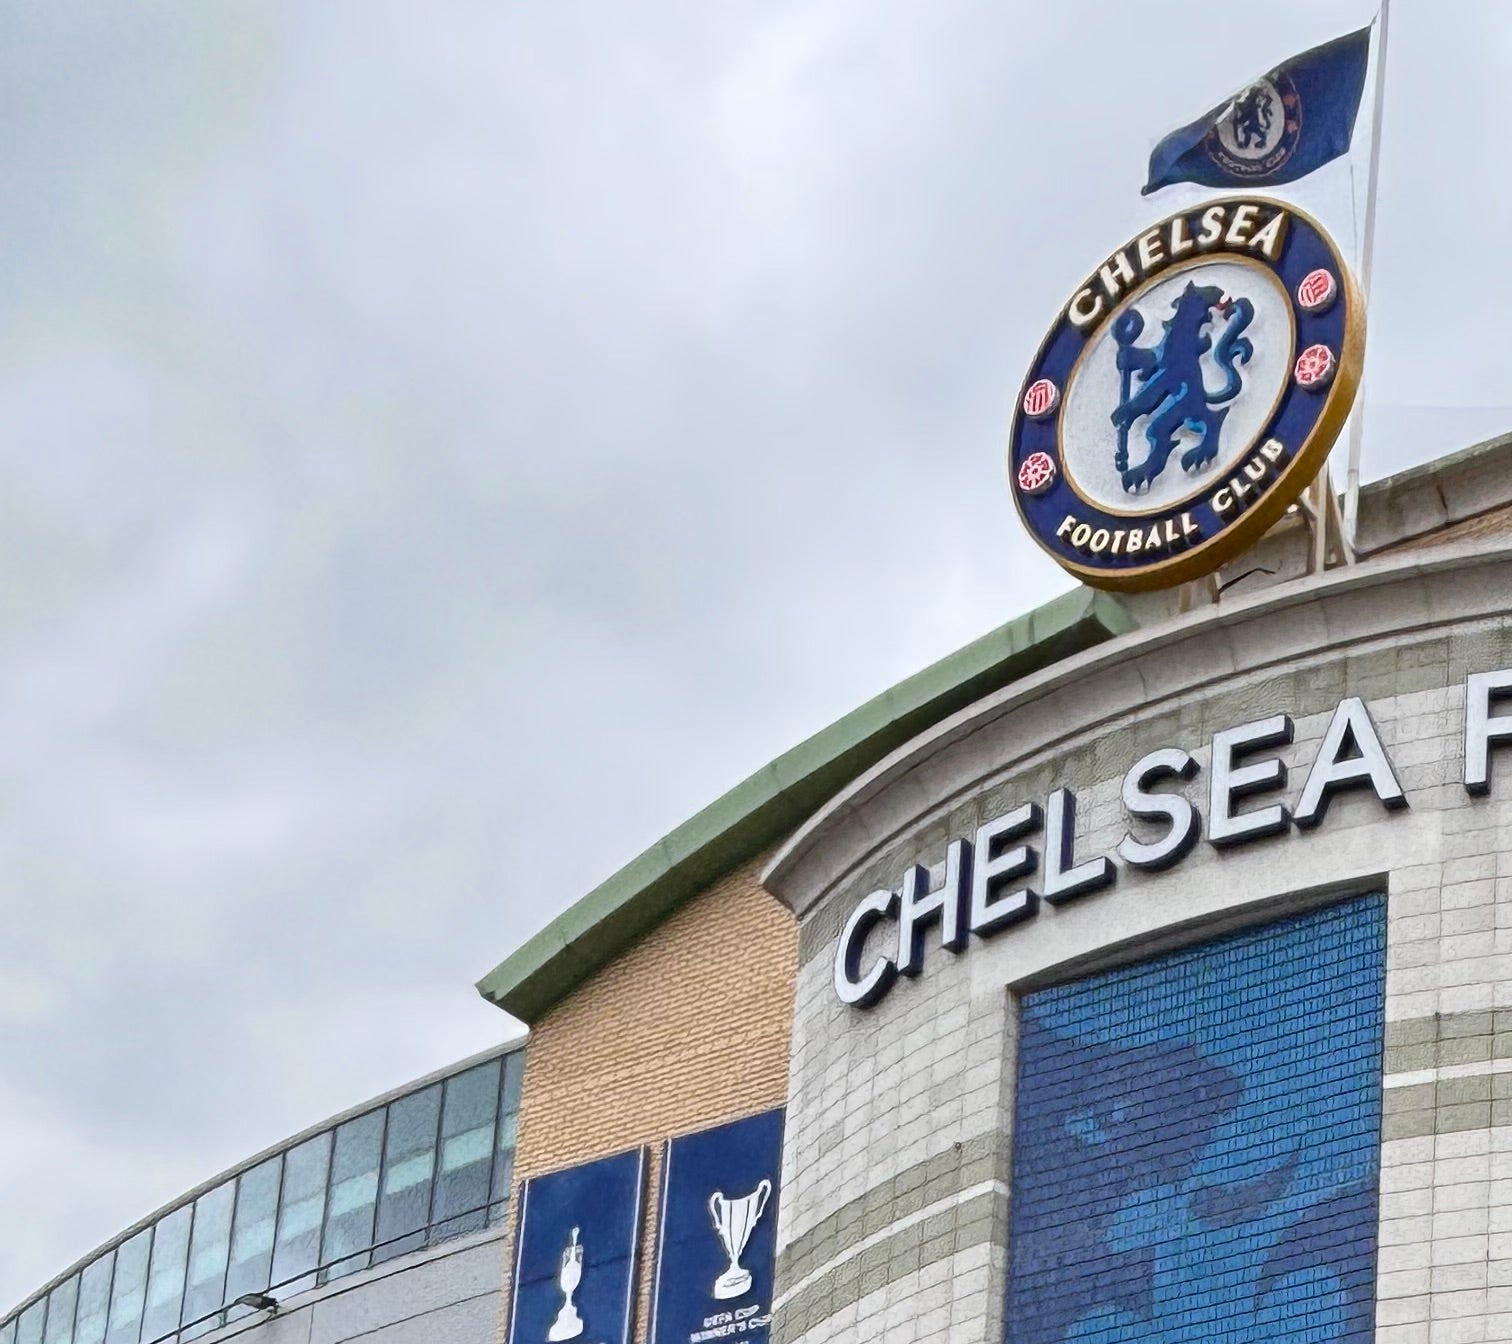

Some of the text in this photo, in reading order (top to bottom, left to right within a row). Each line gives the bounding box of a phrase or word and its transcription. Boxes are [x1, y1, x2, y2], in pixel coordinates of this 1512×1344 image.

[1067, 203, 1287, 328] CHELSEA
[1056, 438, 1286, 555] FOOTBALL CLUB
[835, 696, 1409, 1007] CHELSEA
